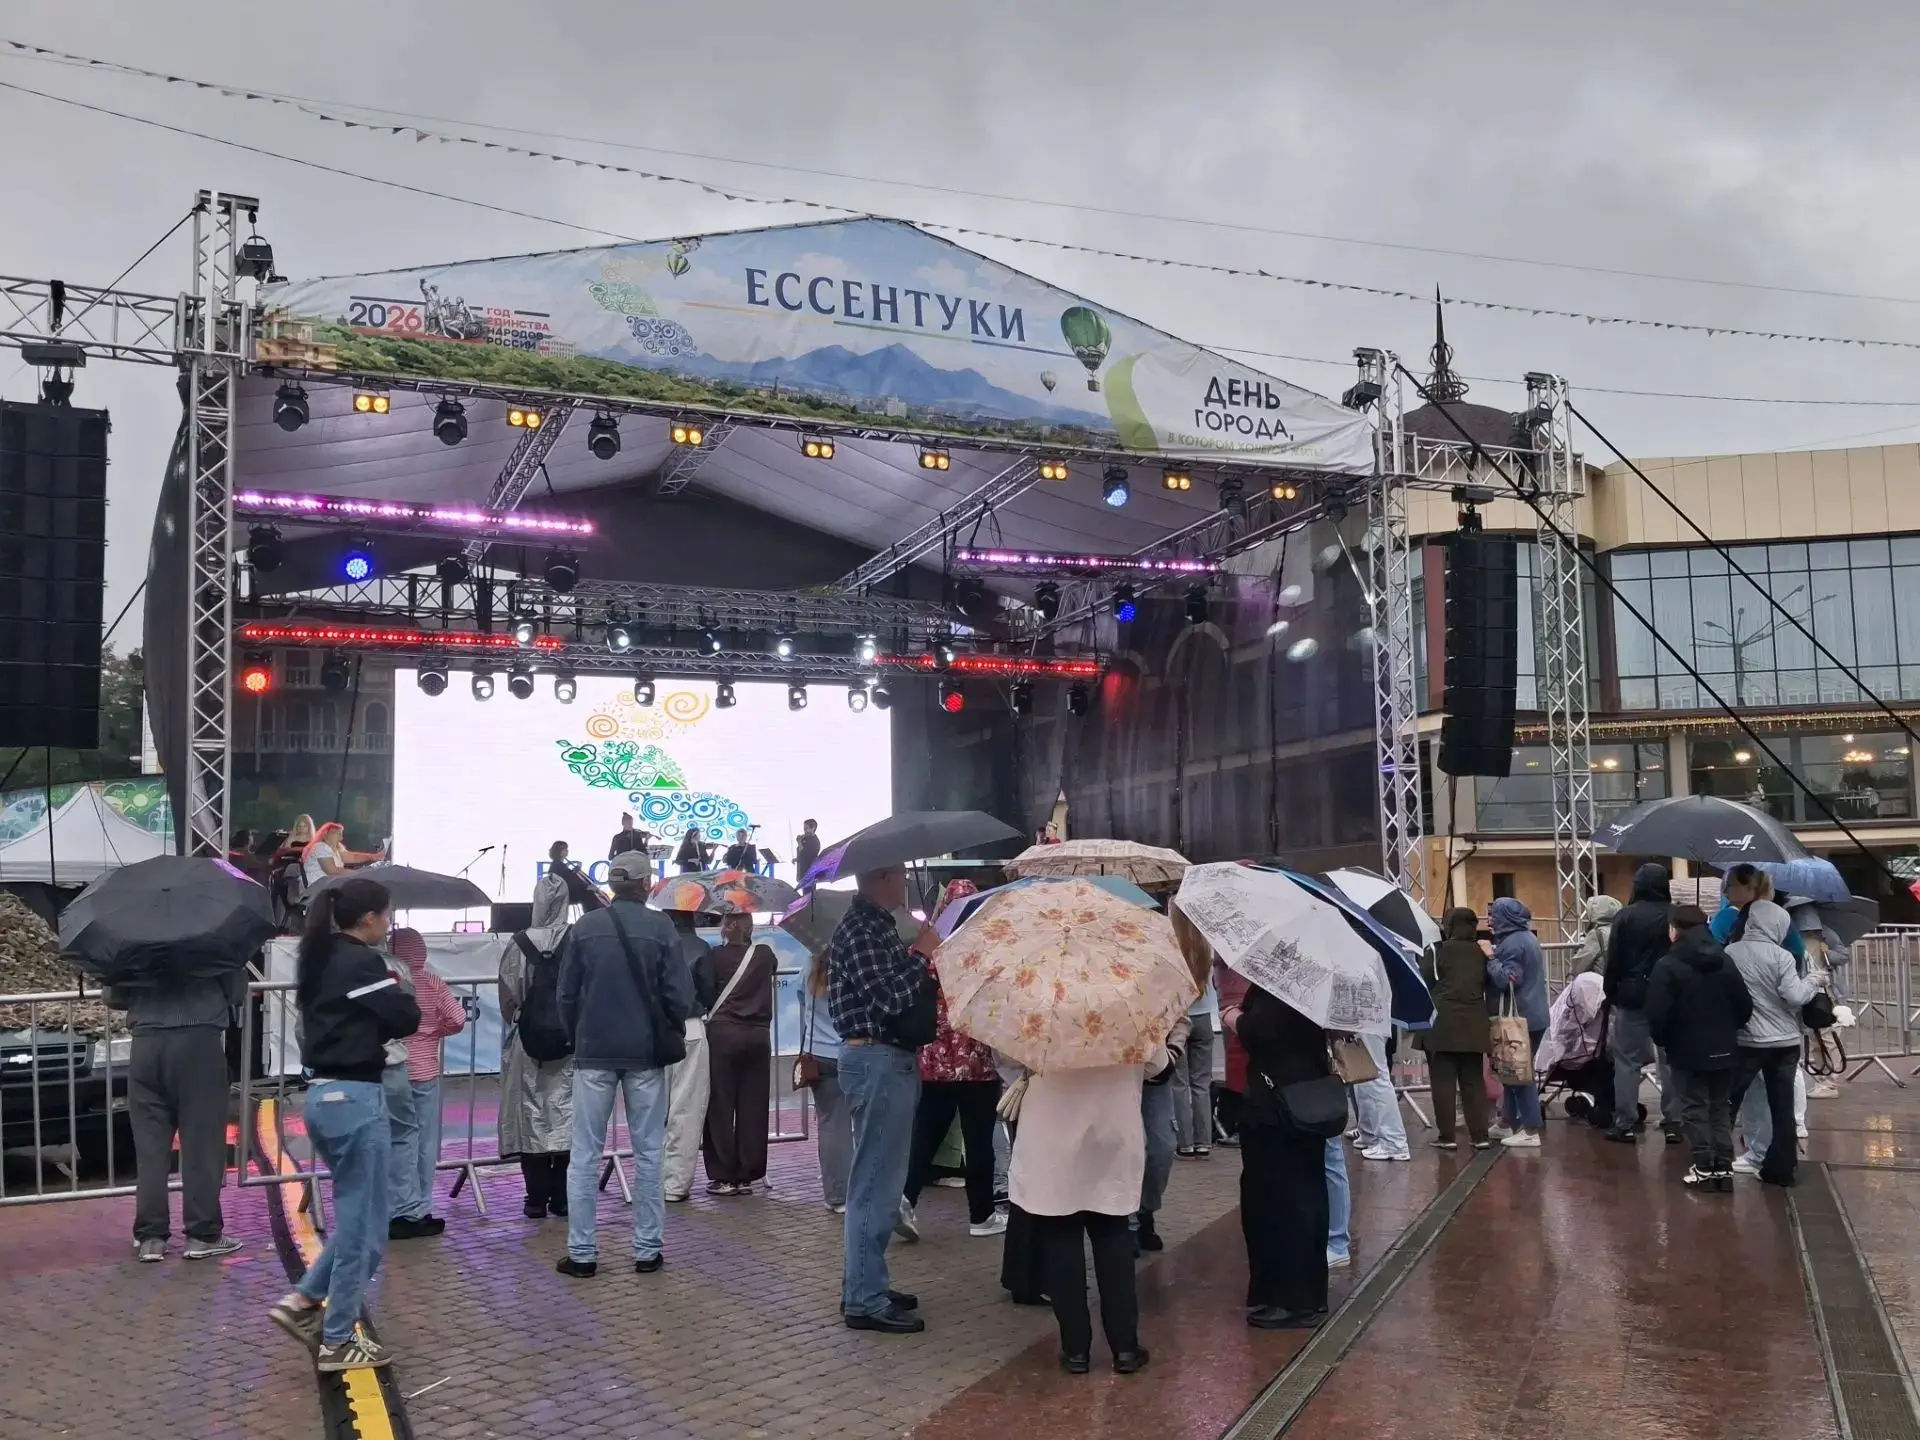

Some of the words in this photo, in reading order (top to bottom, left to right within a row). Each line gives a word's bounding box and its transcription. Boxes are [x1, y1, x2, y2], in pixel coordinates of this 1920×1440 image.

[487, 307, 510, 318] ГОД
[744, 267, 1026, 342] ЕССЕНТУКИ
[349, 302, 422, 332] 2026
[486, 317, 550, 332] ЕДИНСТВА
[486, 337, 537, 350] РОССИИ
[1204, 376, 1281, 410] ДЕНЬ
[1195, 409, 1294, 441] ГОРОДА,
[1167, 432, 1174, 444] В
[1178, 433, 1234, 451] КОТОРОМ
